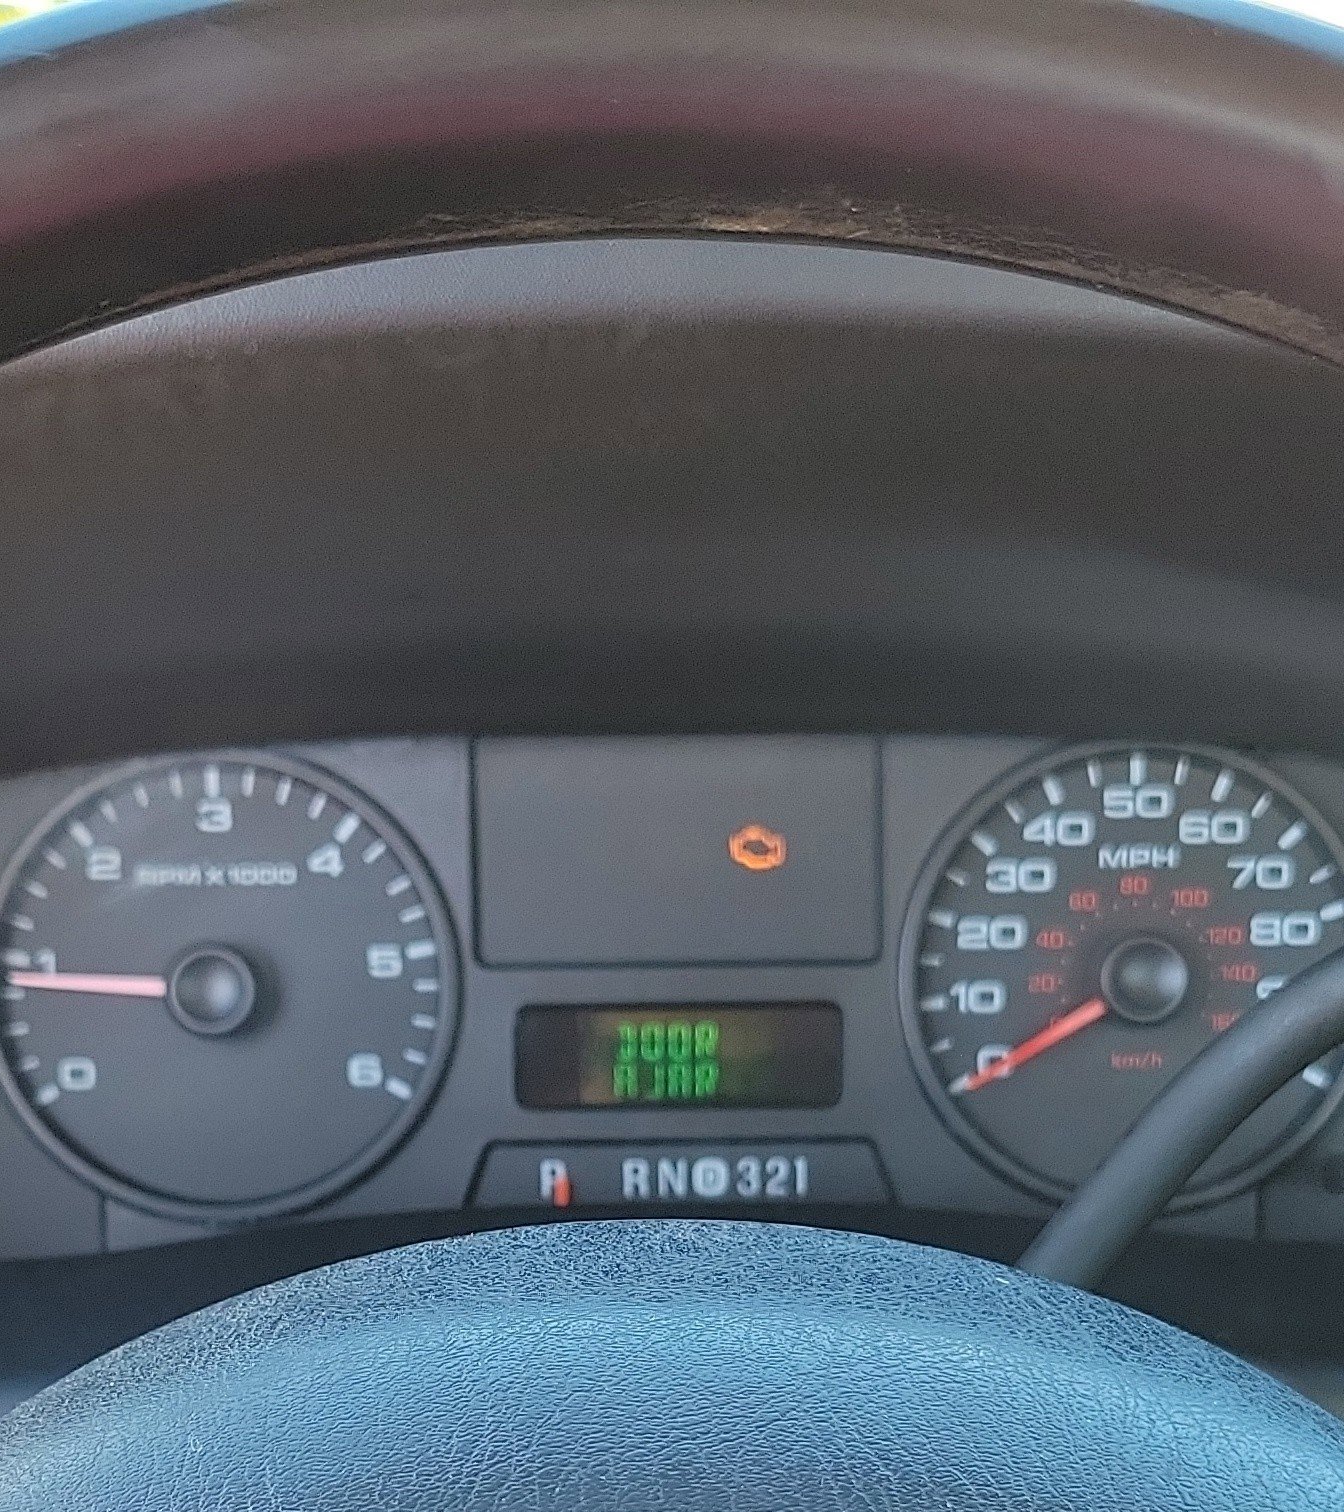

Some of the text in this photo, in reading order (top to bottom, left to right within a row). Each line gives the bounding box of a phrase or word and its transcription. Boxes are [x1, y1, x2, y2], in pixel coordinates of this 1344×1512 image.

[197, 798, 233, 832] 3
[1103, 783, 1175, 819] 50
[1023, 810, 1095, 846] 40
[1179, 808, 1251, 845] 60
[86, 846, 123, 881] 2
[307, 842, 344, 878] 4
[1098, 843, 1181, 868] MPH
[1227, 853, 1296, 890] 70
[986, 857, 1056, 893] 30
[1120, 876, 1149, 895] 80
[1069, 891, 1099, 911] 60
[1174, 888, 1212, 908] 100
[957, 914, 1028, 950] 20
[1035, 930, 1066, 949] 40
[1250, 911, 1322, 947] 80
[32, 949, 56, 974] 1
[366, 943, 403, 977] 5
[949, 979, 1005, 1014] 10
[58, 1055, 98, 1091] 0
[346, 1052, 384, 1088] 6
